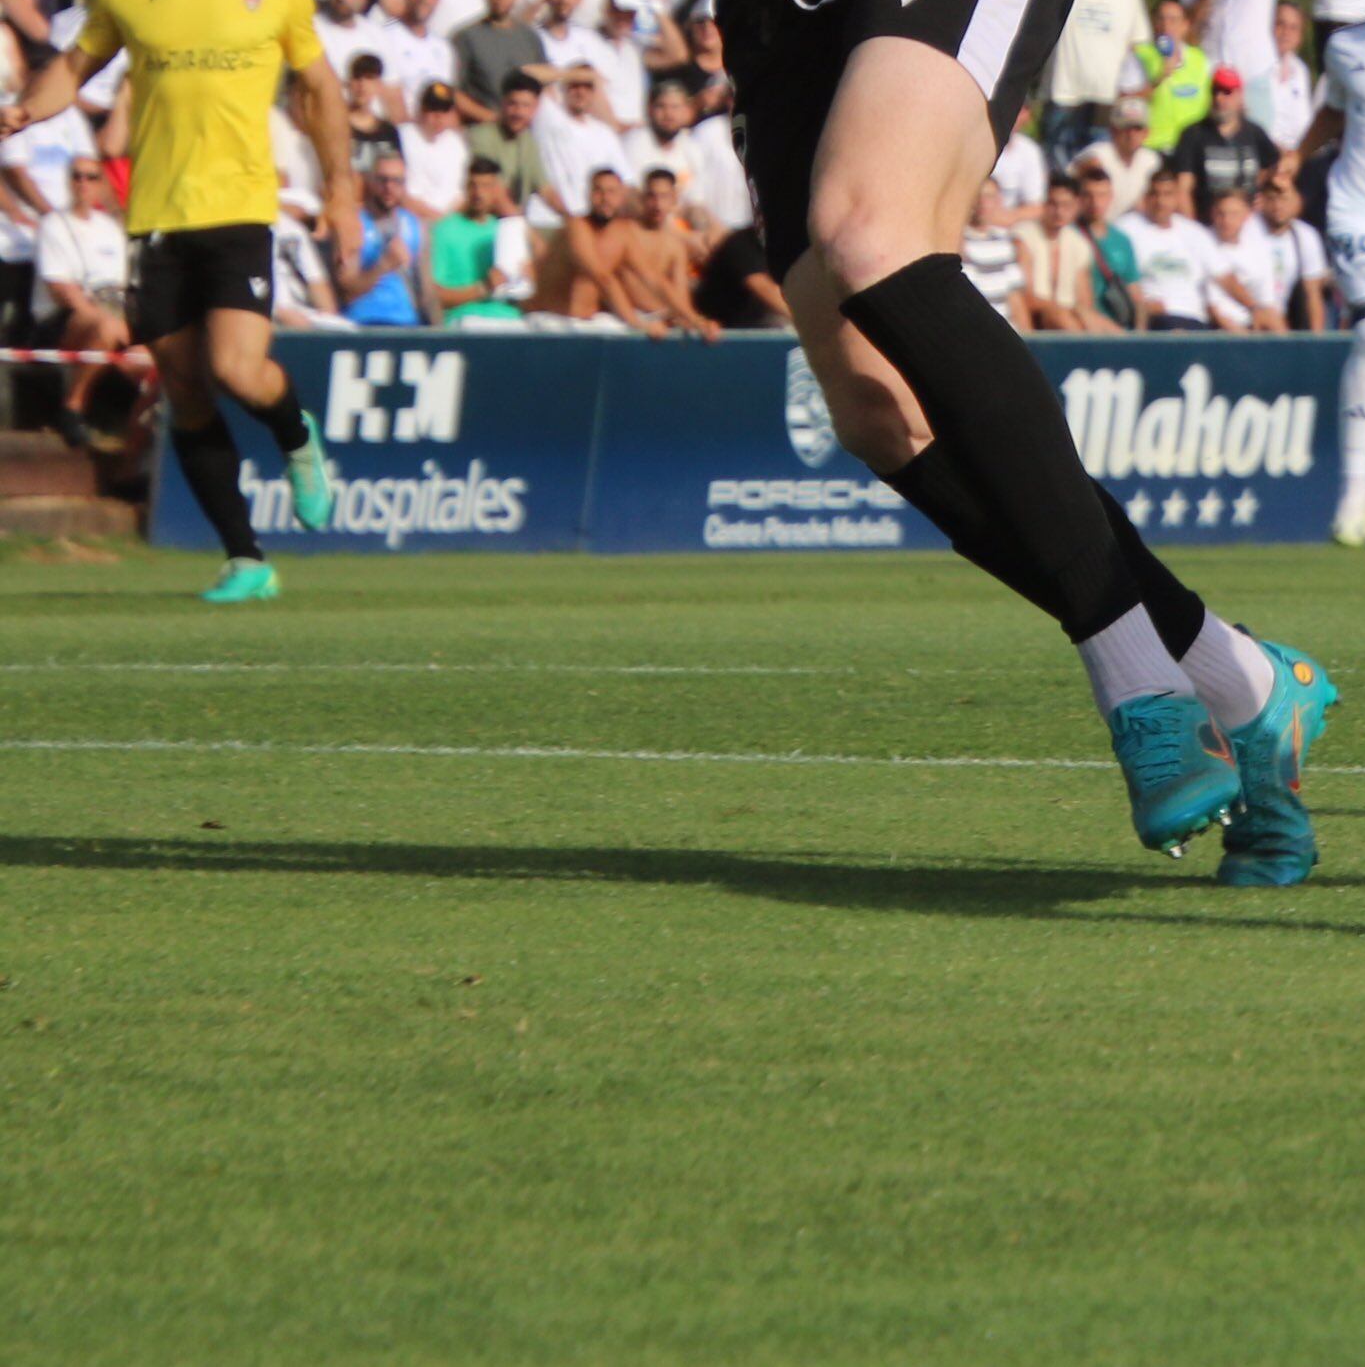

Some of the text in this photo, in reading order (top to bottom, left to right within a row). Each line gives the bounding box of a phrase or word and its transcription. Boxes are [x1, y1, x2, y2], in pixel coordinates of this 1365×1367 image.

[1060, 363, 1318, 479] Mahou
[326, 457, 529, 550] hospitales
[707, 479, 906, 510] PORSCHE
